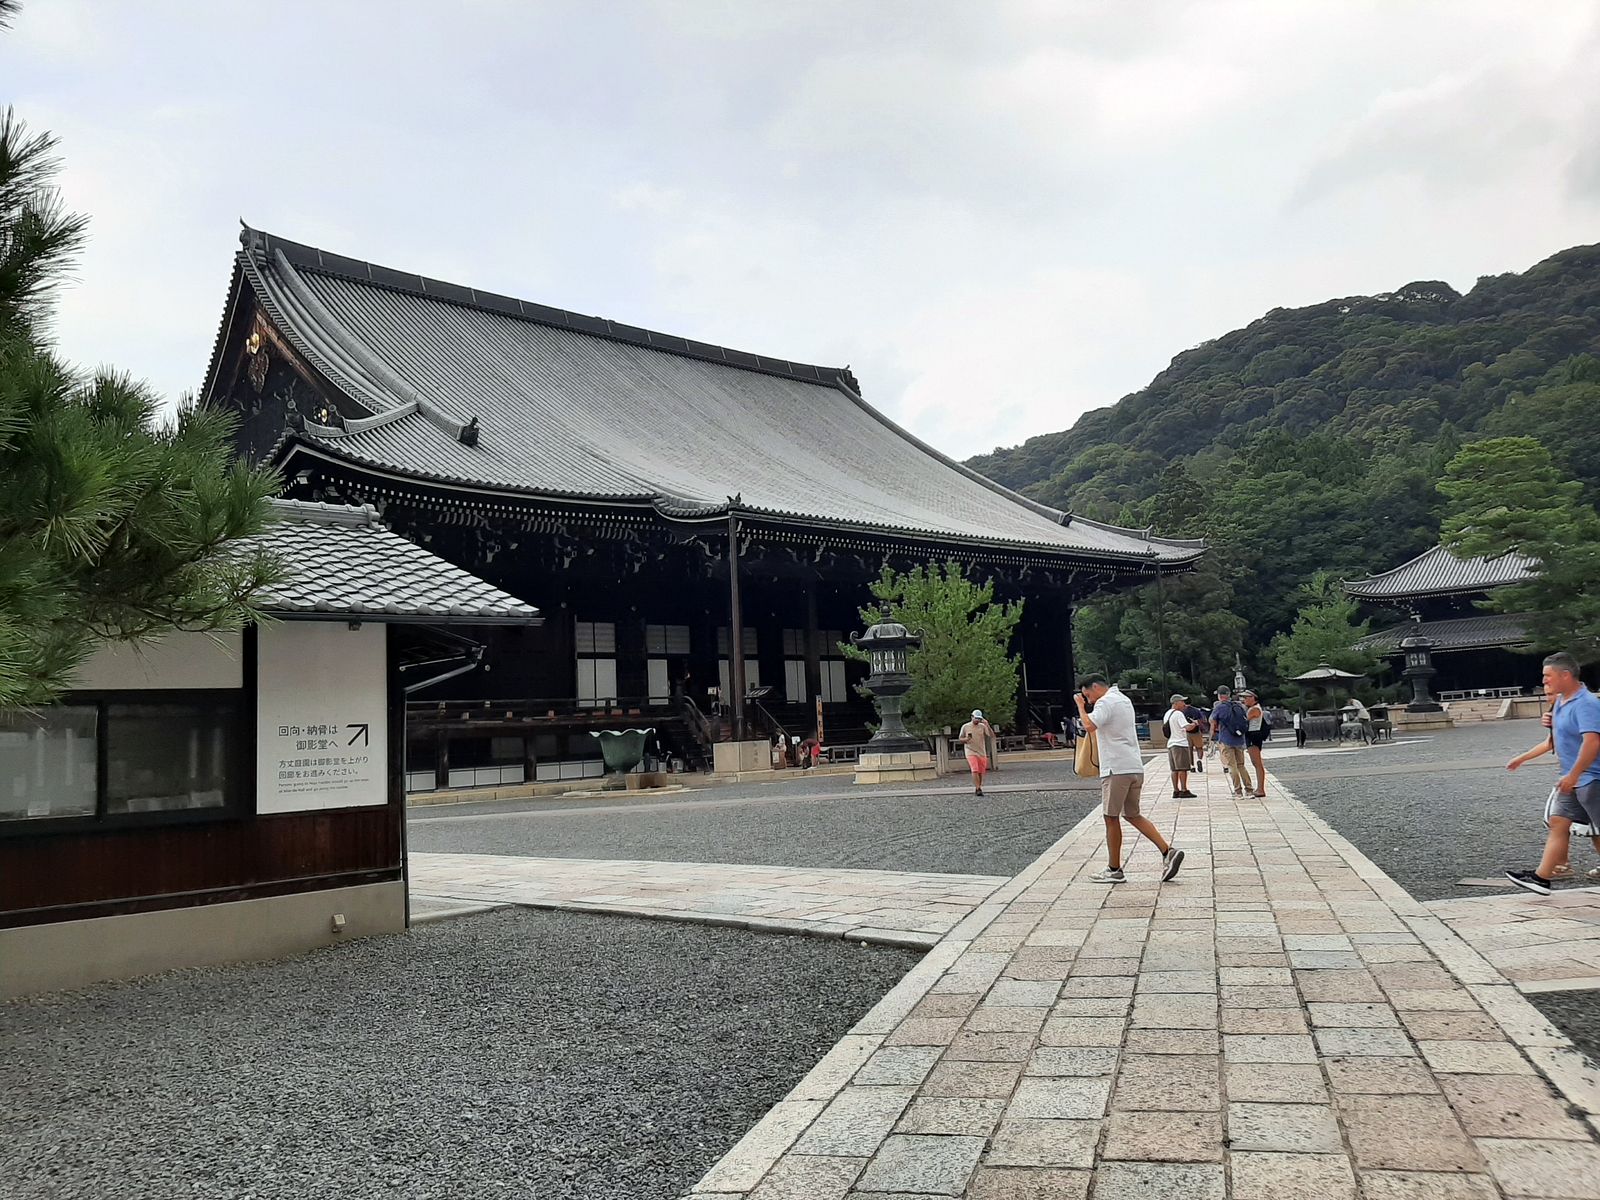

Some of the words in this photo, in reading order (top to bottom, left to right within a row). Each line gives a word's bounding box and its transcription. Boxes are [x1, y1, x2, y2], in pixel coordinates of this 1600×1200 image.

[278, 725, 338, 736] 回向・納骨は
[296, 740, 339, 750] 御影堂へ
